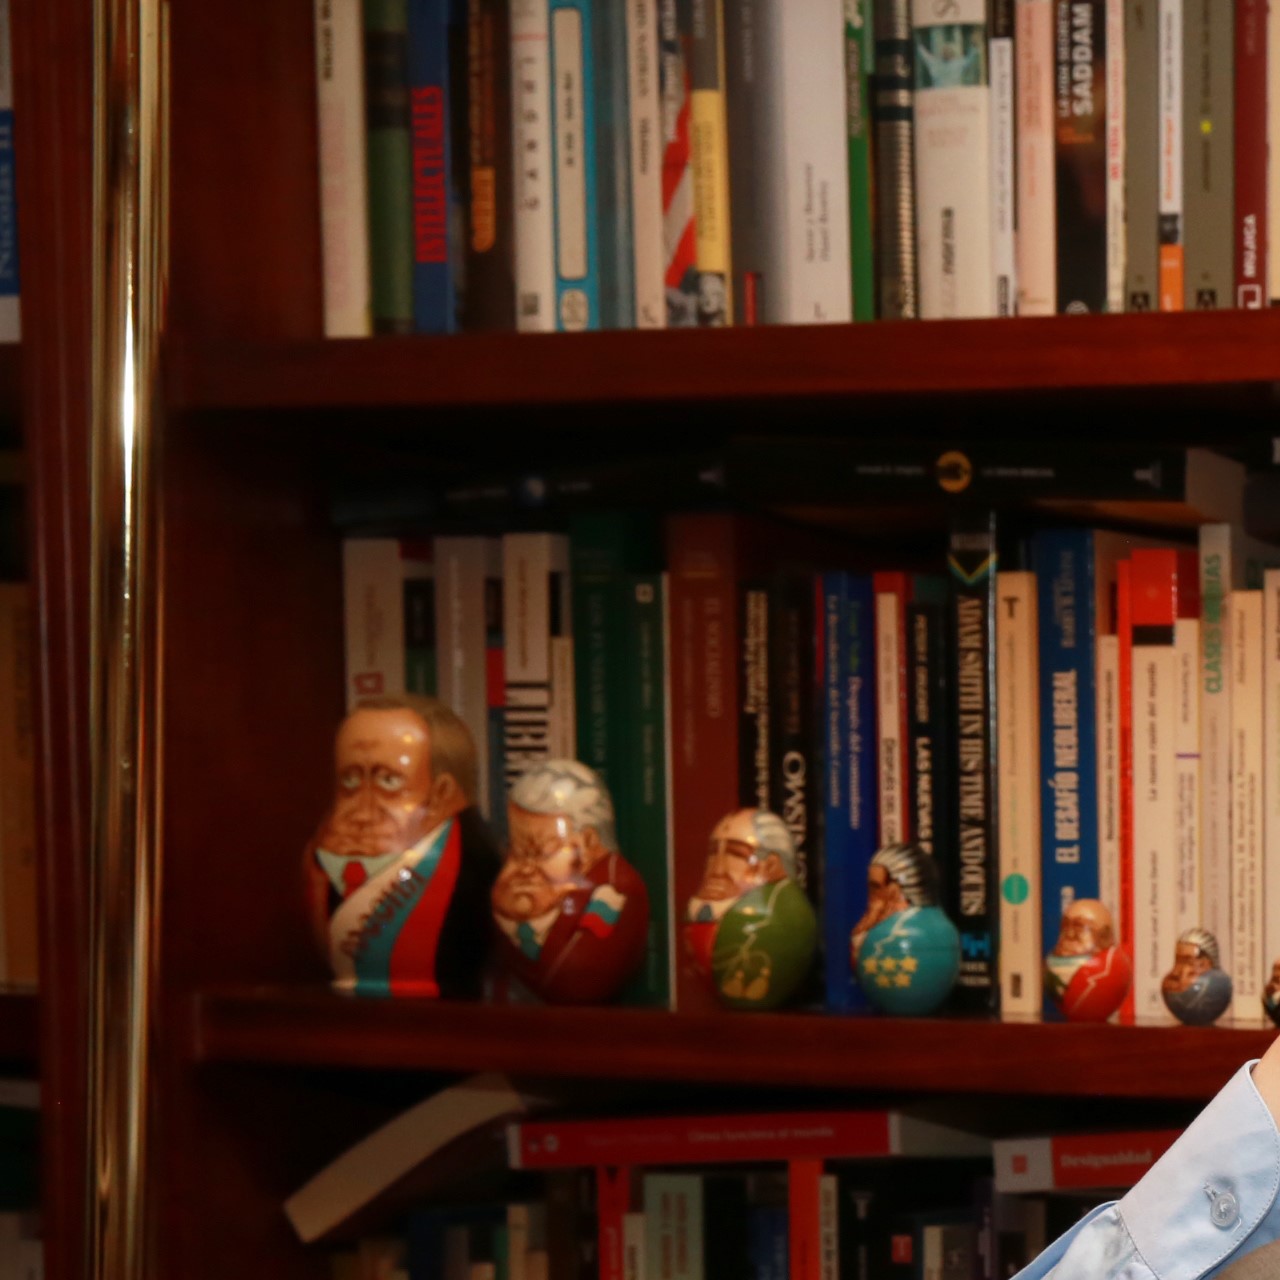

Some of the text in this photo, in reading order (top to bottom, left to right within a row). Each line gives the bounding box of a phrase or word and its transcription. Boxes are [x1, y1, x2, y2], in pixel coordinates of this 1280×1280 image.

[1071, 3, 1093, 117] SADDAM
[1203, 620, 1226, 694] CLASES
[916, 736, 932, 772] LAS
[958, 598, 986, 916] ADAM SMITH IN HIS TIME AND OURS
[1049, 667, 1081, 864] EL DESAFÍO NEOLIBERAL
